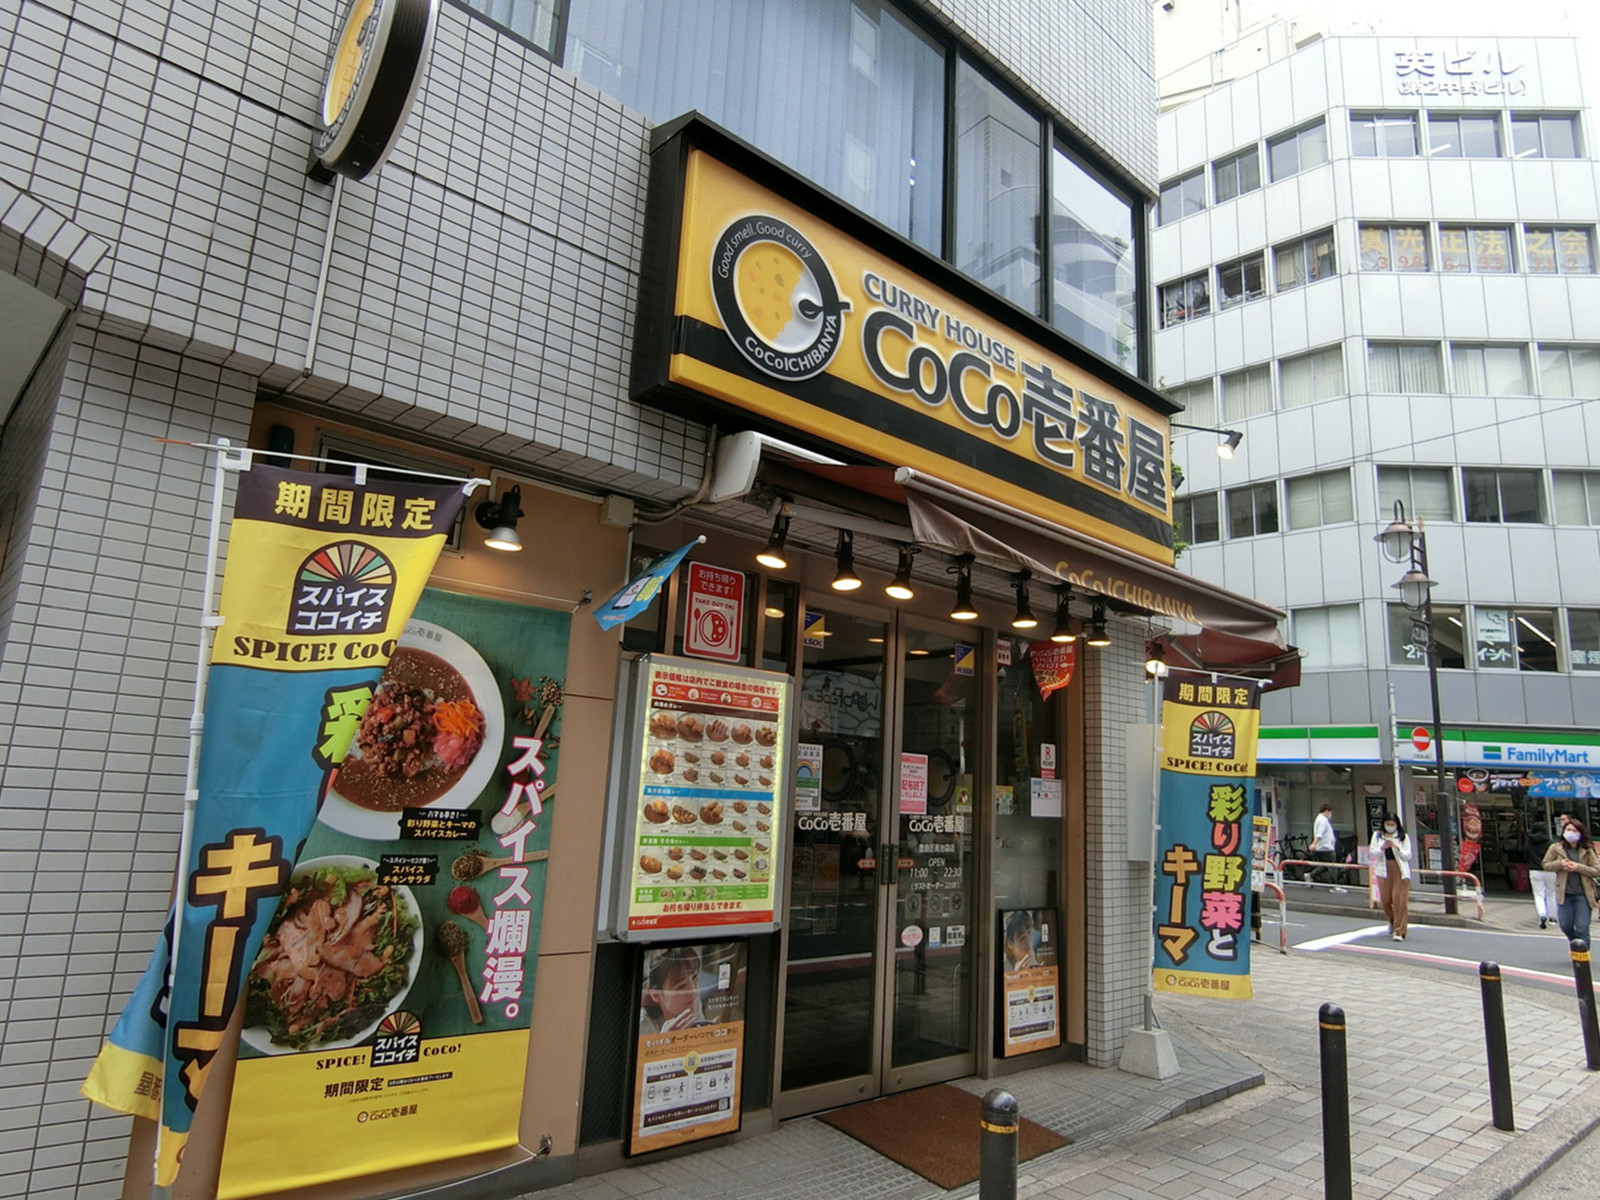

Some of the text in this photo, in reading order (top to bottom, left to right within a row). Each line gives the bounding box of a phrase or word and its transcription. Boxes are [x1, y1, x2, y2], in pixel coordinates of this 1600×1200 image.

[718, 242, 734, 279] Good
[756, 221, 785, 238] Good
[786, 234, 812, 259] curry
[864, 272, 1016, 372] CURRY HOUSE
[745, 315, 838, 372] CoCoICHIBANYA
[863, 309, 1168, 513] CoCo壱番屋
[274, 481, 437, 531] 期間限定
[698, 569, 736, 585] お持ち帰り
[297, 584, 388, 607] スパイス
[695, 597, 710, 606] TAKE
[711, 600, 724, 608] OUT
[294, 609, 384, 632] ココイチ
[233, 634, 336, 663] SPICE!
[805, 637, 822, 647] LSOK
[1179, 682, 1248, 705] 期間限定
[1192, 733, 1232, 745] スパイス
[1192, 745, 1232, 757] ココイチ
[1507, 747, 1589, 764] FamilyMart
[1167, 756, 1213, 771] SPICE!
[407, 819, 477, 829] 彩り野菜とキーマの
[798, 811, 867, 832] CoCo壱番屋
[909, 815, 965, 833] CoCo壱番屋
[414, 829, 468, 838] スパイスカレー
[392, 866, 424, 874] スパイス
[928, 857, 946, 867] OPEN
[383, 875, 431, 884] チキンサラダ
[910, 867, 929, 878] 11:00
[943, 867, 962, 877] 22:30
[1201, 785, 1244, 958] 彩り野菜と
[1159, 846, 1197, 963] キーマ
[375, 1035, 418, 1051] スパイス
[423, 1043, 462, 1057] CoCo!
[316, 1054, 366, 1070] SPICE!
[373, 1048, 417, 1064] ココイチ
[324, 1078, 384, 1098] 期間限定
[370, 1104, 418, 1121] CoCo壱番屋
